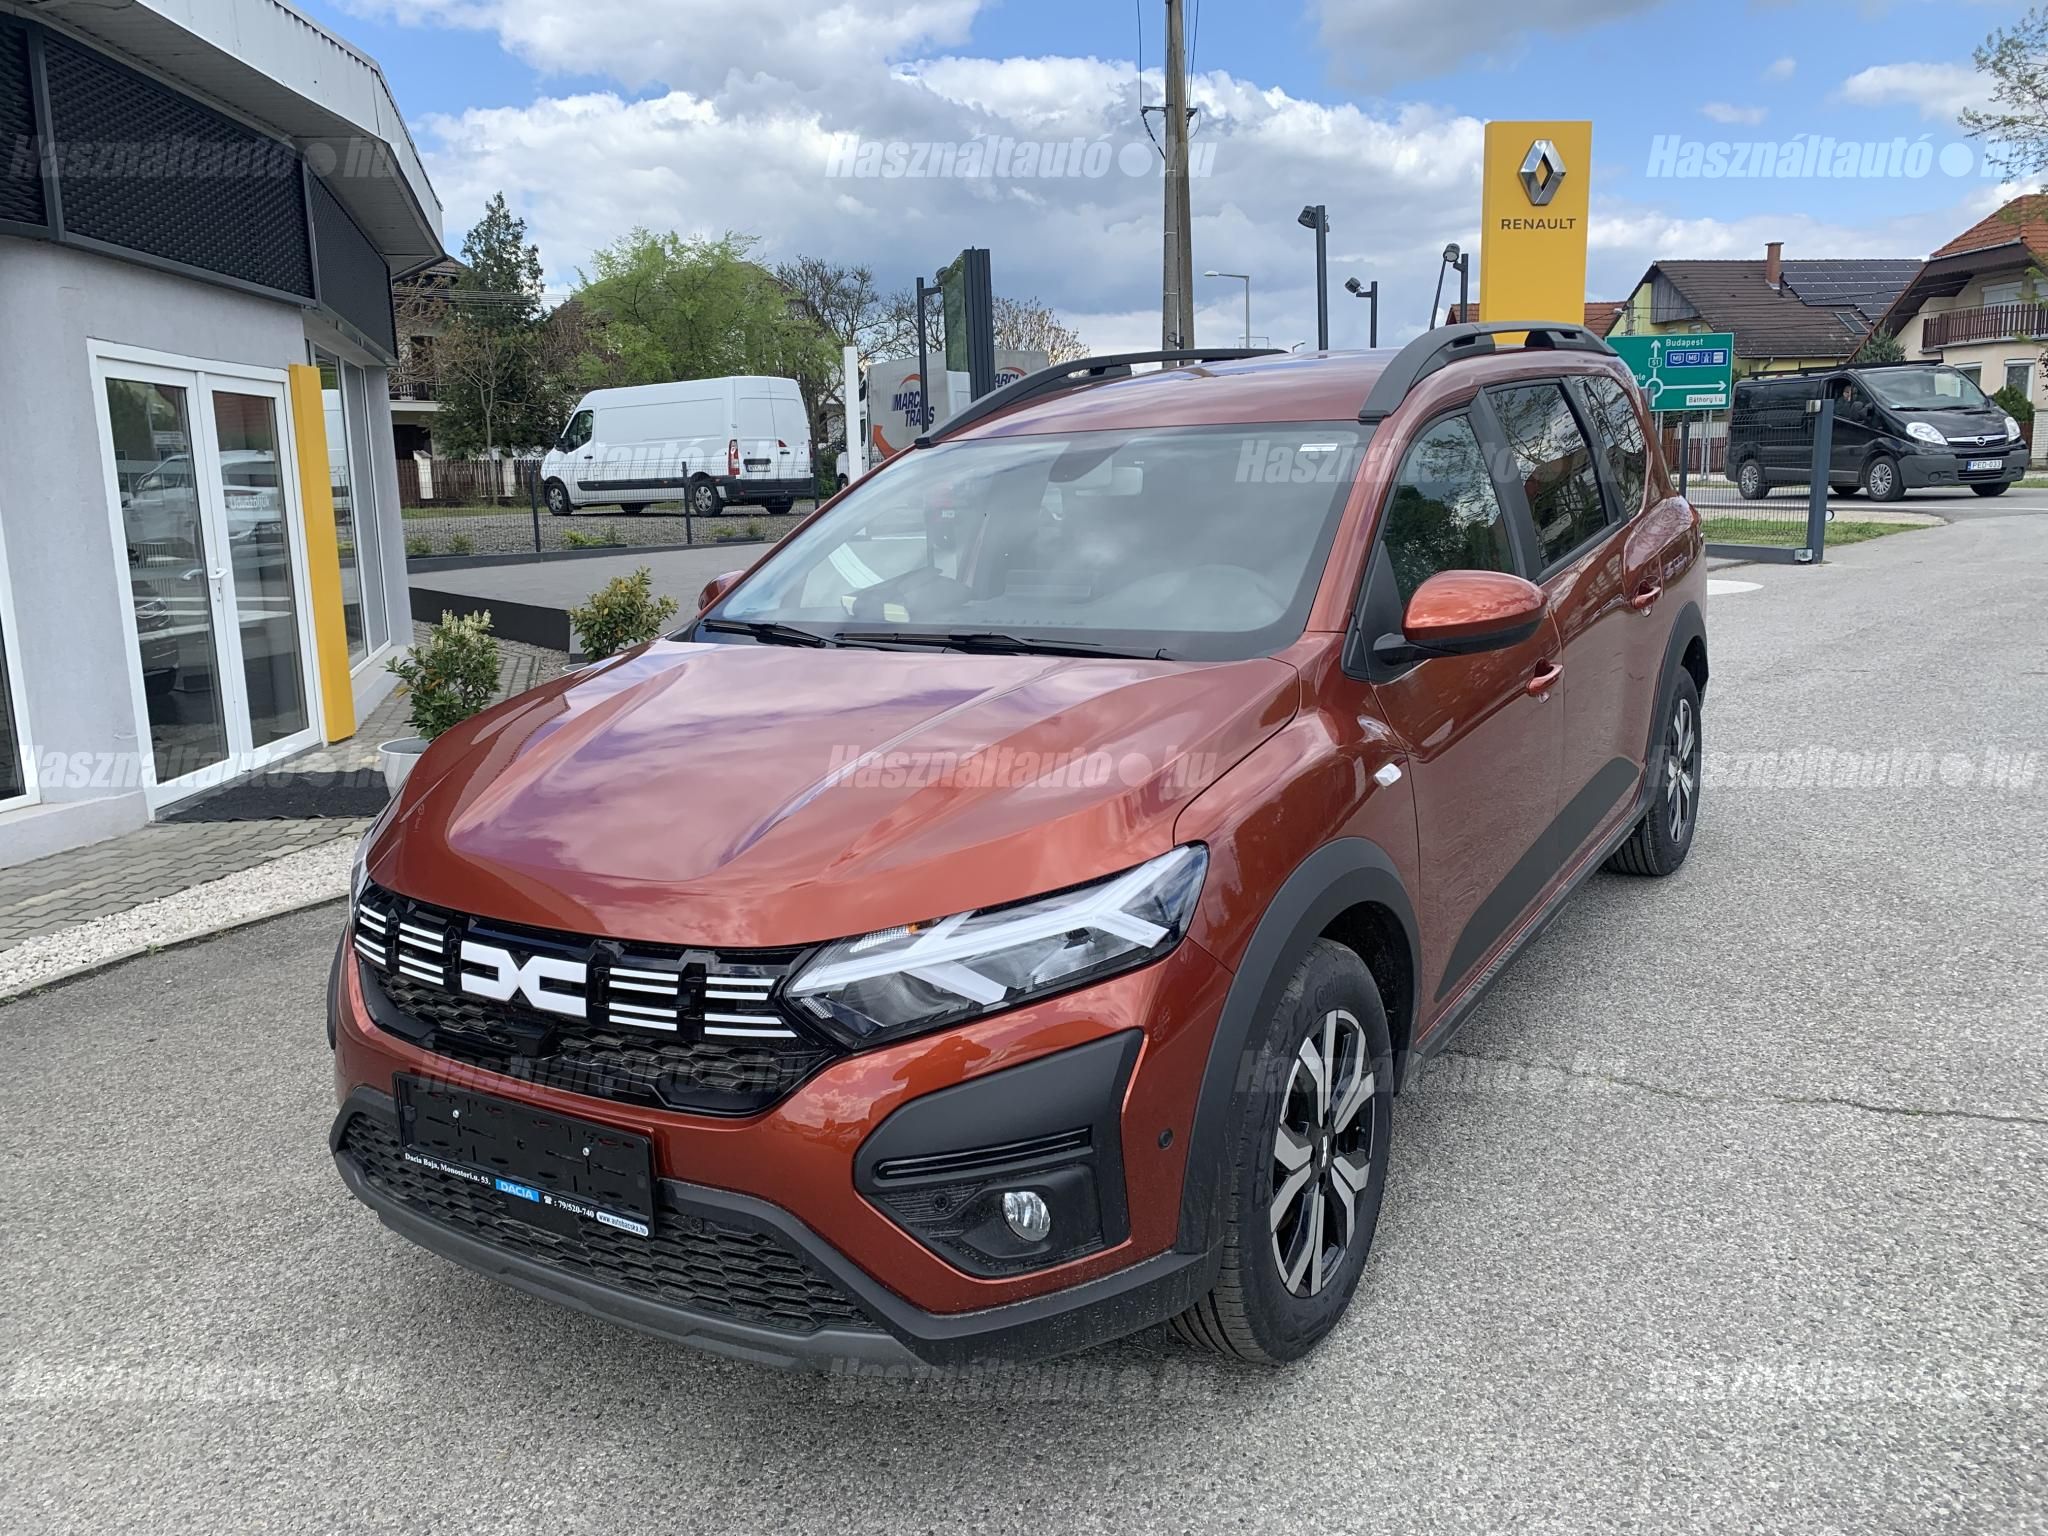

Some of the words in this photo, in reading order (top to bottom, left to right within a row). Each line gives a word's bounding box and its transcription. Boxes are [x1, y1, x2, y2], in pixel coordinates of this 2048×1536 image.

[1501, 218, 1576, 230] RENAULT
[1666, 338, 1703, 347] Budapest
[893, 390, 921, 412] MARC
[904, 406, 935, 428] TRAS
[404, 1152, 422, 1164] Dacia
[423, 1158, 440, 1171] Baja,
[500, 1181, 534, 1200] DACIA
